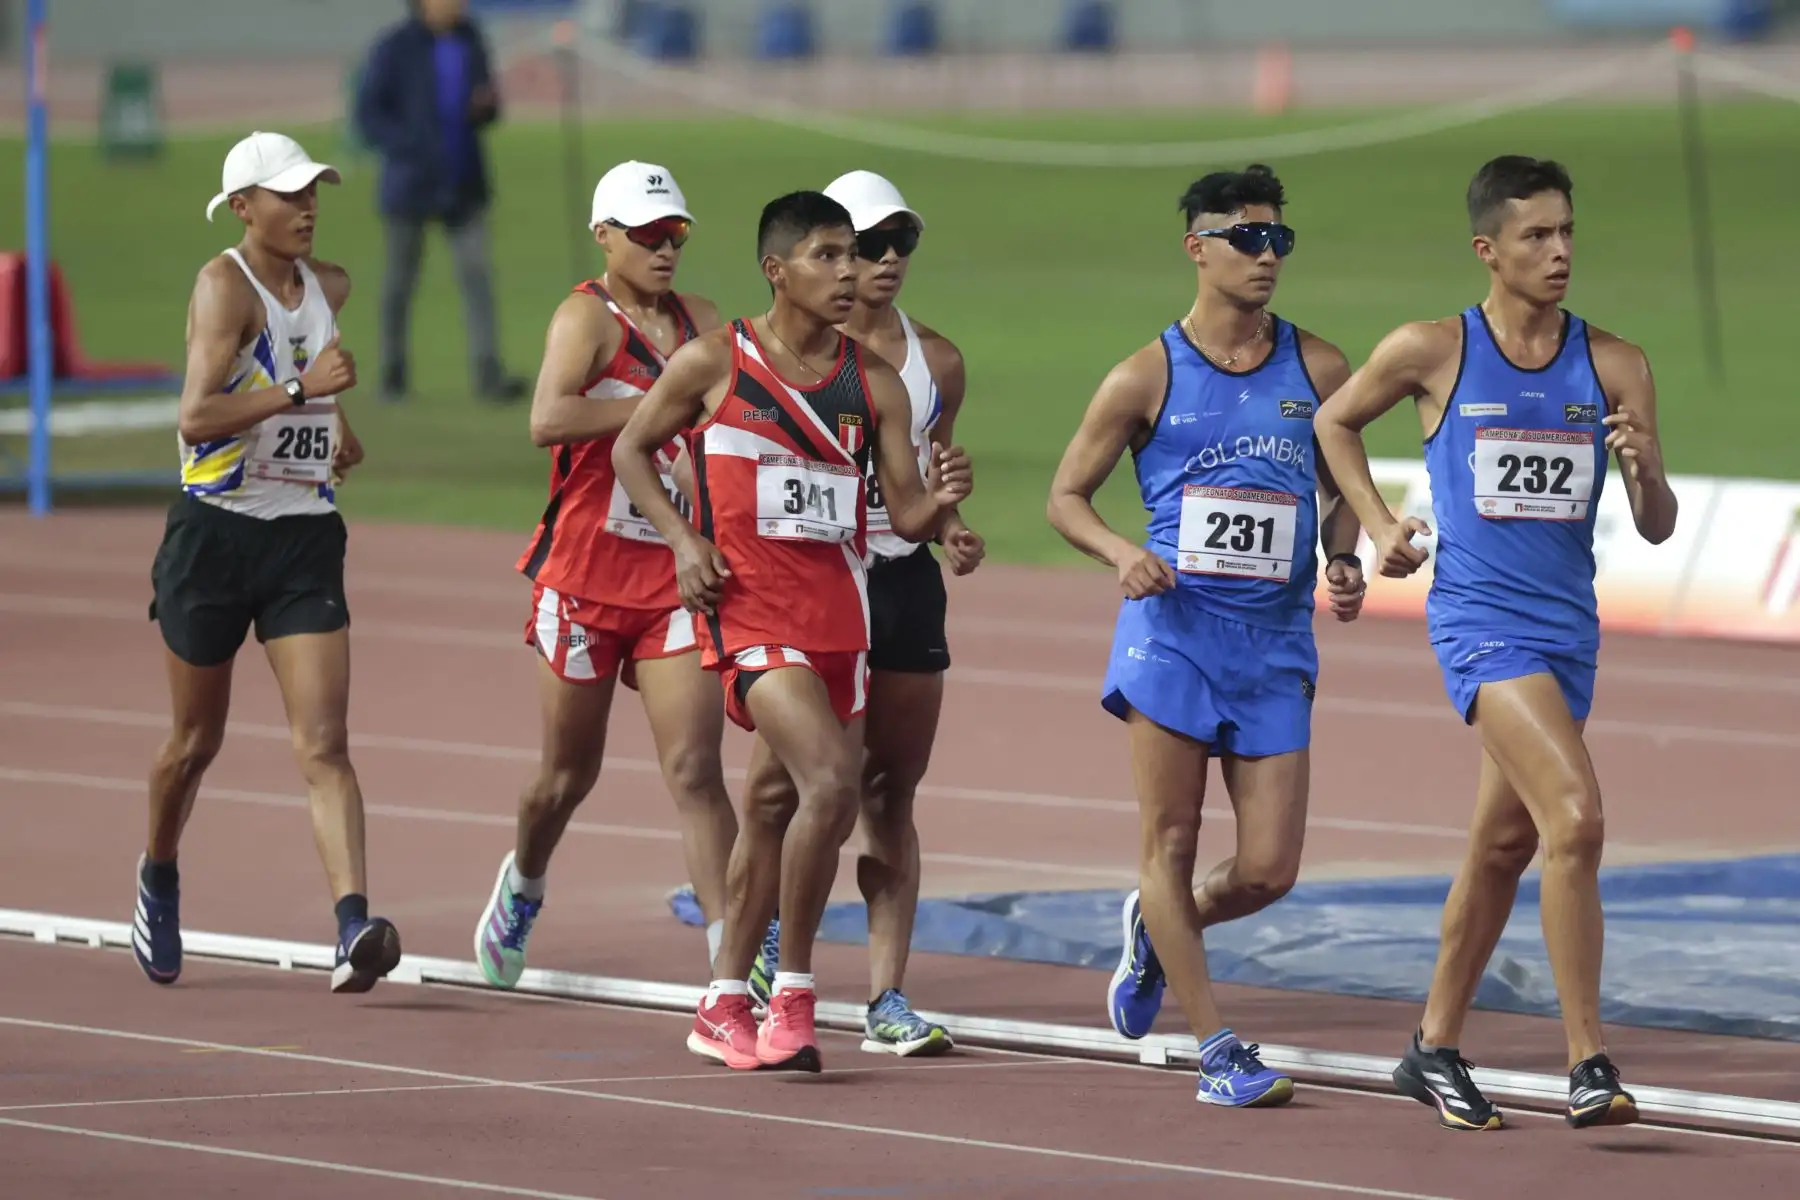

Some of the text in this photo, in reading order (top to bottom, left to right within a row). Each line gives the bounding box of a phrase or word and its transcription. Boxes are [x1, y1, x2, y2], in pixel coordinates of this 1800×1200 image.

[743, 407, 778, 422] PERÚ
[272, 425, 329, 461] 285
[1187, 486, 1232, 498] CAMPEONATO
[1497, 453, 1574, 495] 232
[783, 478, 838, 521] 341
[1204, 511, 1275, 554] 231
